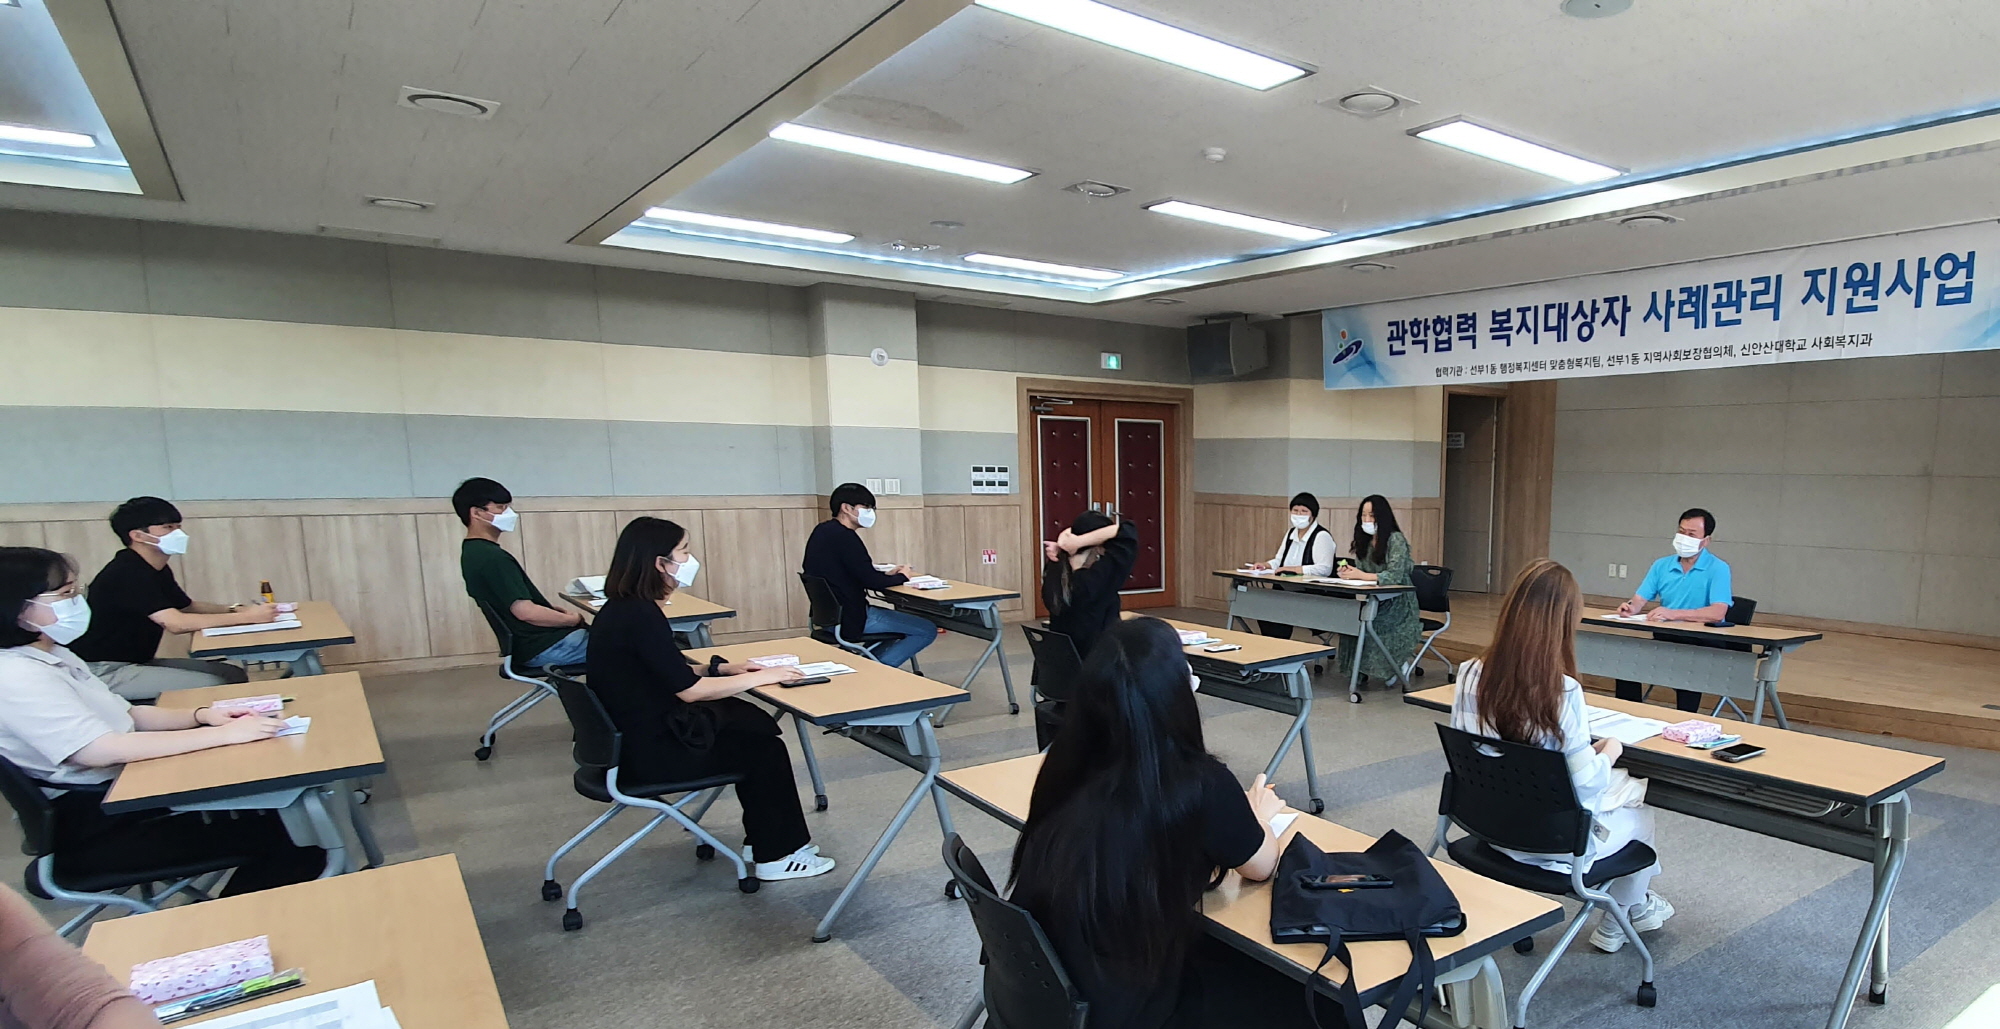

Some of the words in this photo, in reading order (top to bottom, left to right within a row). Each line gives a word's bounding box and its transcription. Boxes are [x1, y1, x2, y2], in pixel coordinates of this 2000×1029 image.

[1387, 312, 1478, 356] 관학협력
[1489, 294, 1631, 347] 복지대상자
[1643, 273, 1783, 332] 사례관리
[1801, 250, 1976, 316] 지원사업
[1435, 366, 1463, 377] 협력기관
[1470, 364, 1498, 375] 선부1동
[1500, 361, 1547, 374] 행정복지센터
[1550, 356, 1603, 371] 맞춤형복지팀,
[1607, 353, 1640, 366] 선부1동
[1643, 345, 1736, 363] 지역사회보장협의체,
[1741, 339, 1807, 356] 신안산대학교
[1811, 333, 1872, 351] 사회복지과
